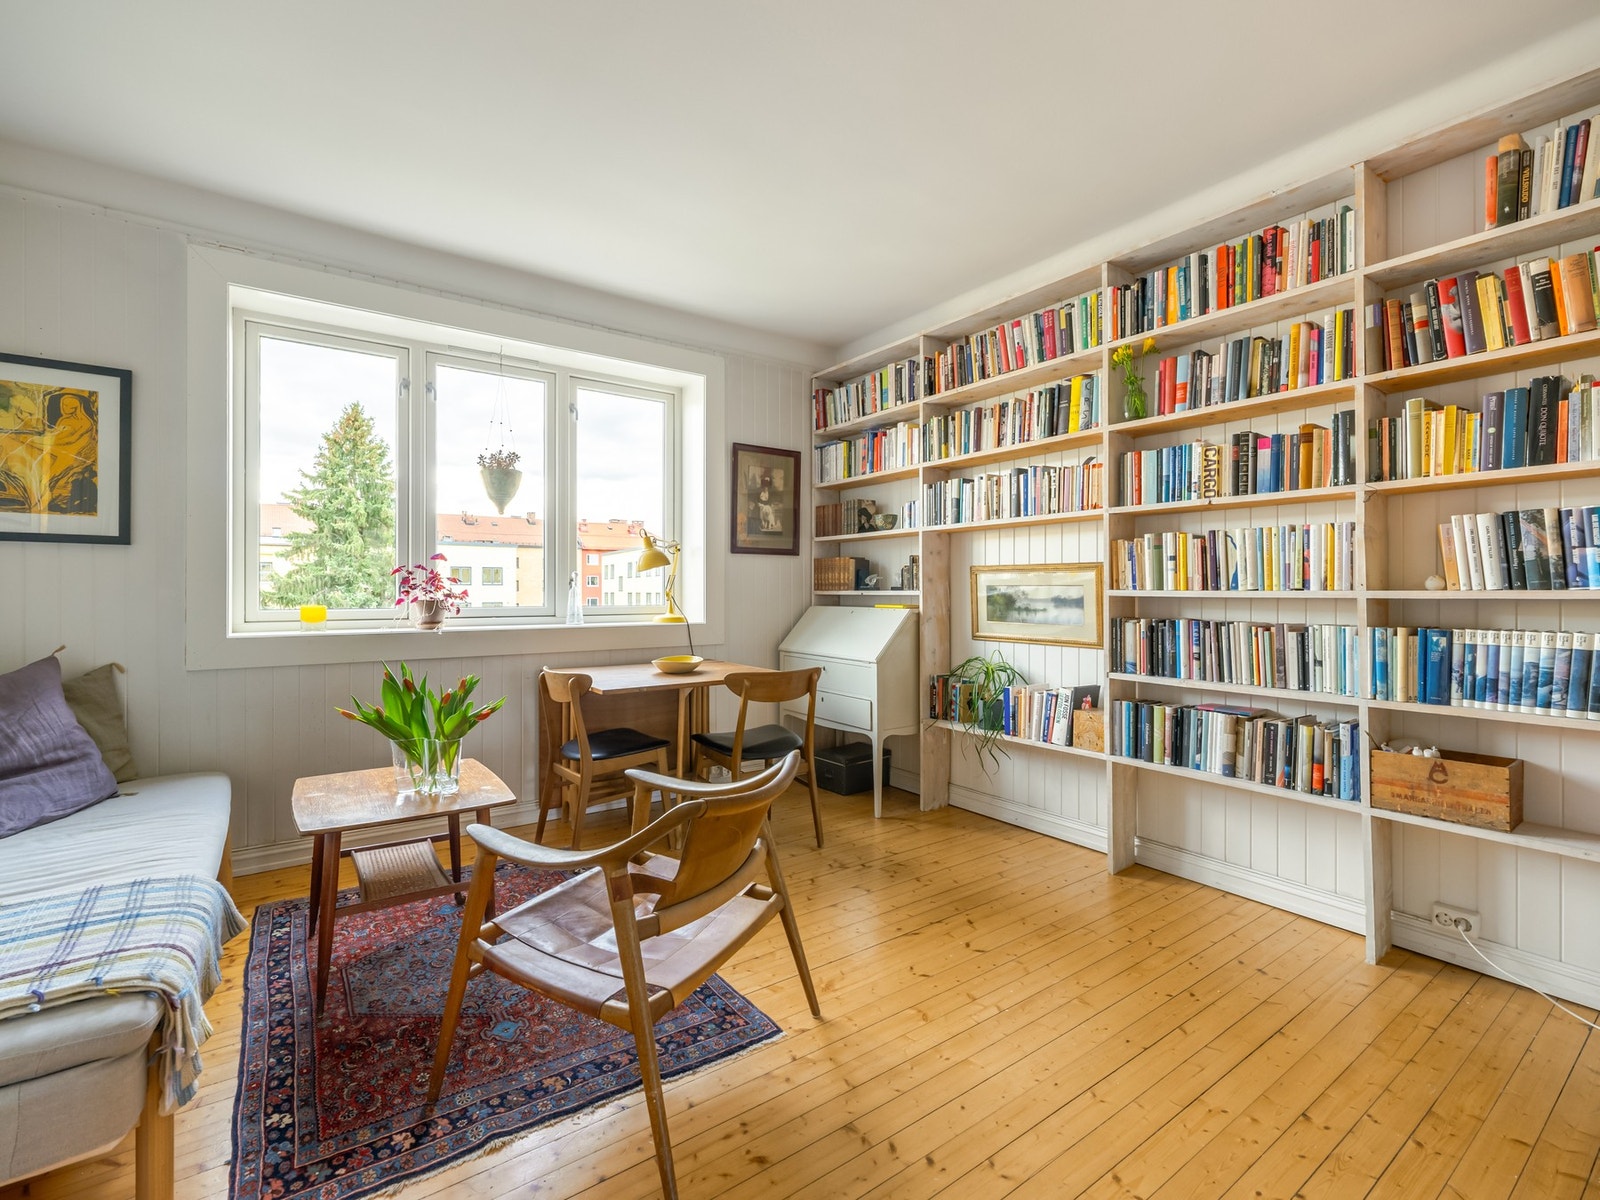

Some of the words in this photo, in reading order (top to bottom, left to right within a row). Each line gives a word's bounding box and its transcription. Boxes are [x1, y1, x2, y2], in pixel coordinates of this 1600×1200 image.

[1540, 407, 1548, 421] DON
[1203, 447, 1217, 498] CARGO
[1062, 703, 1070, 720] FOSSE
